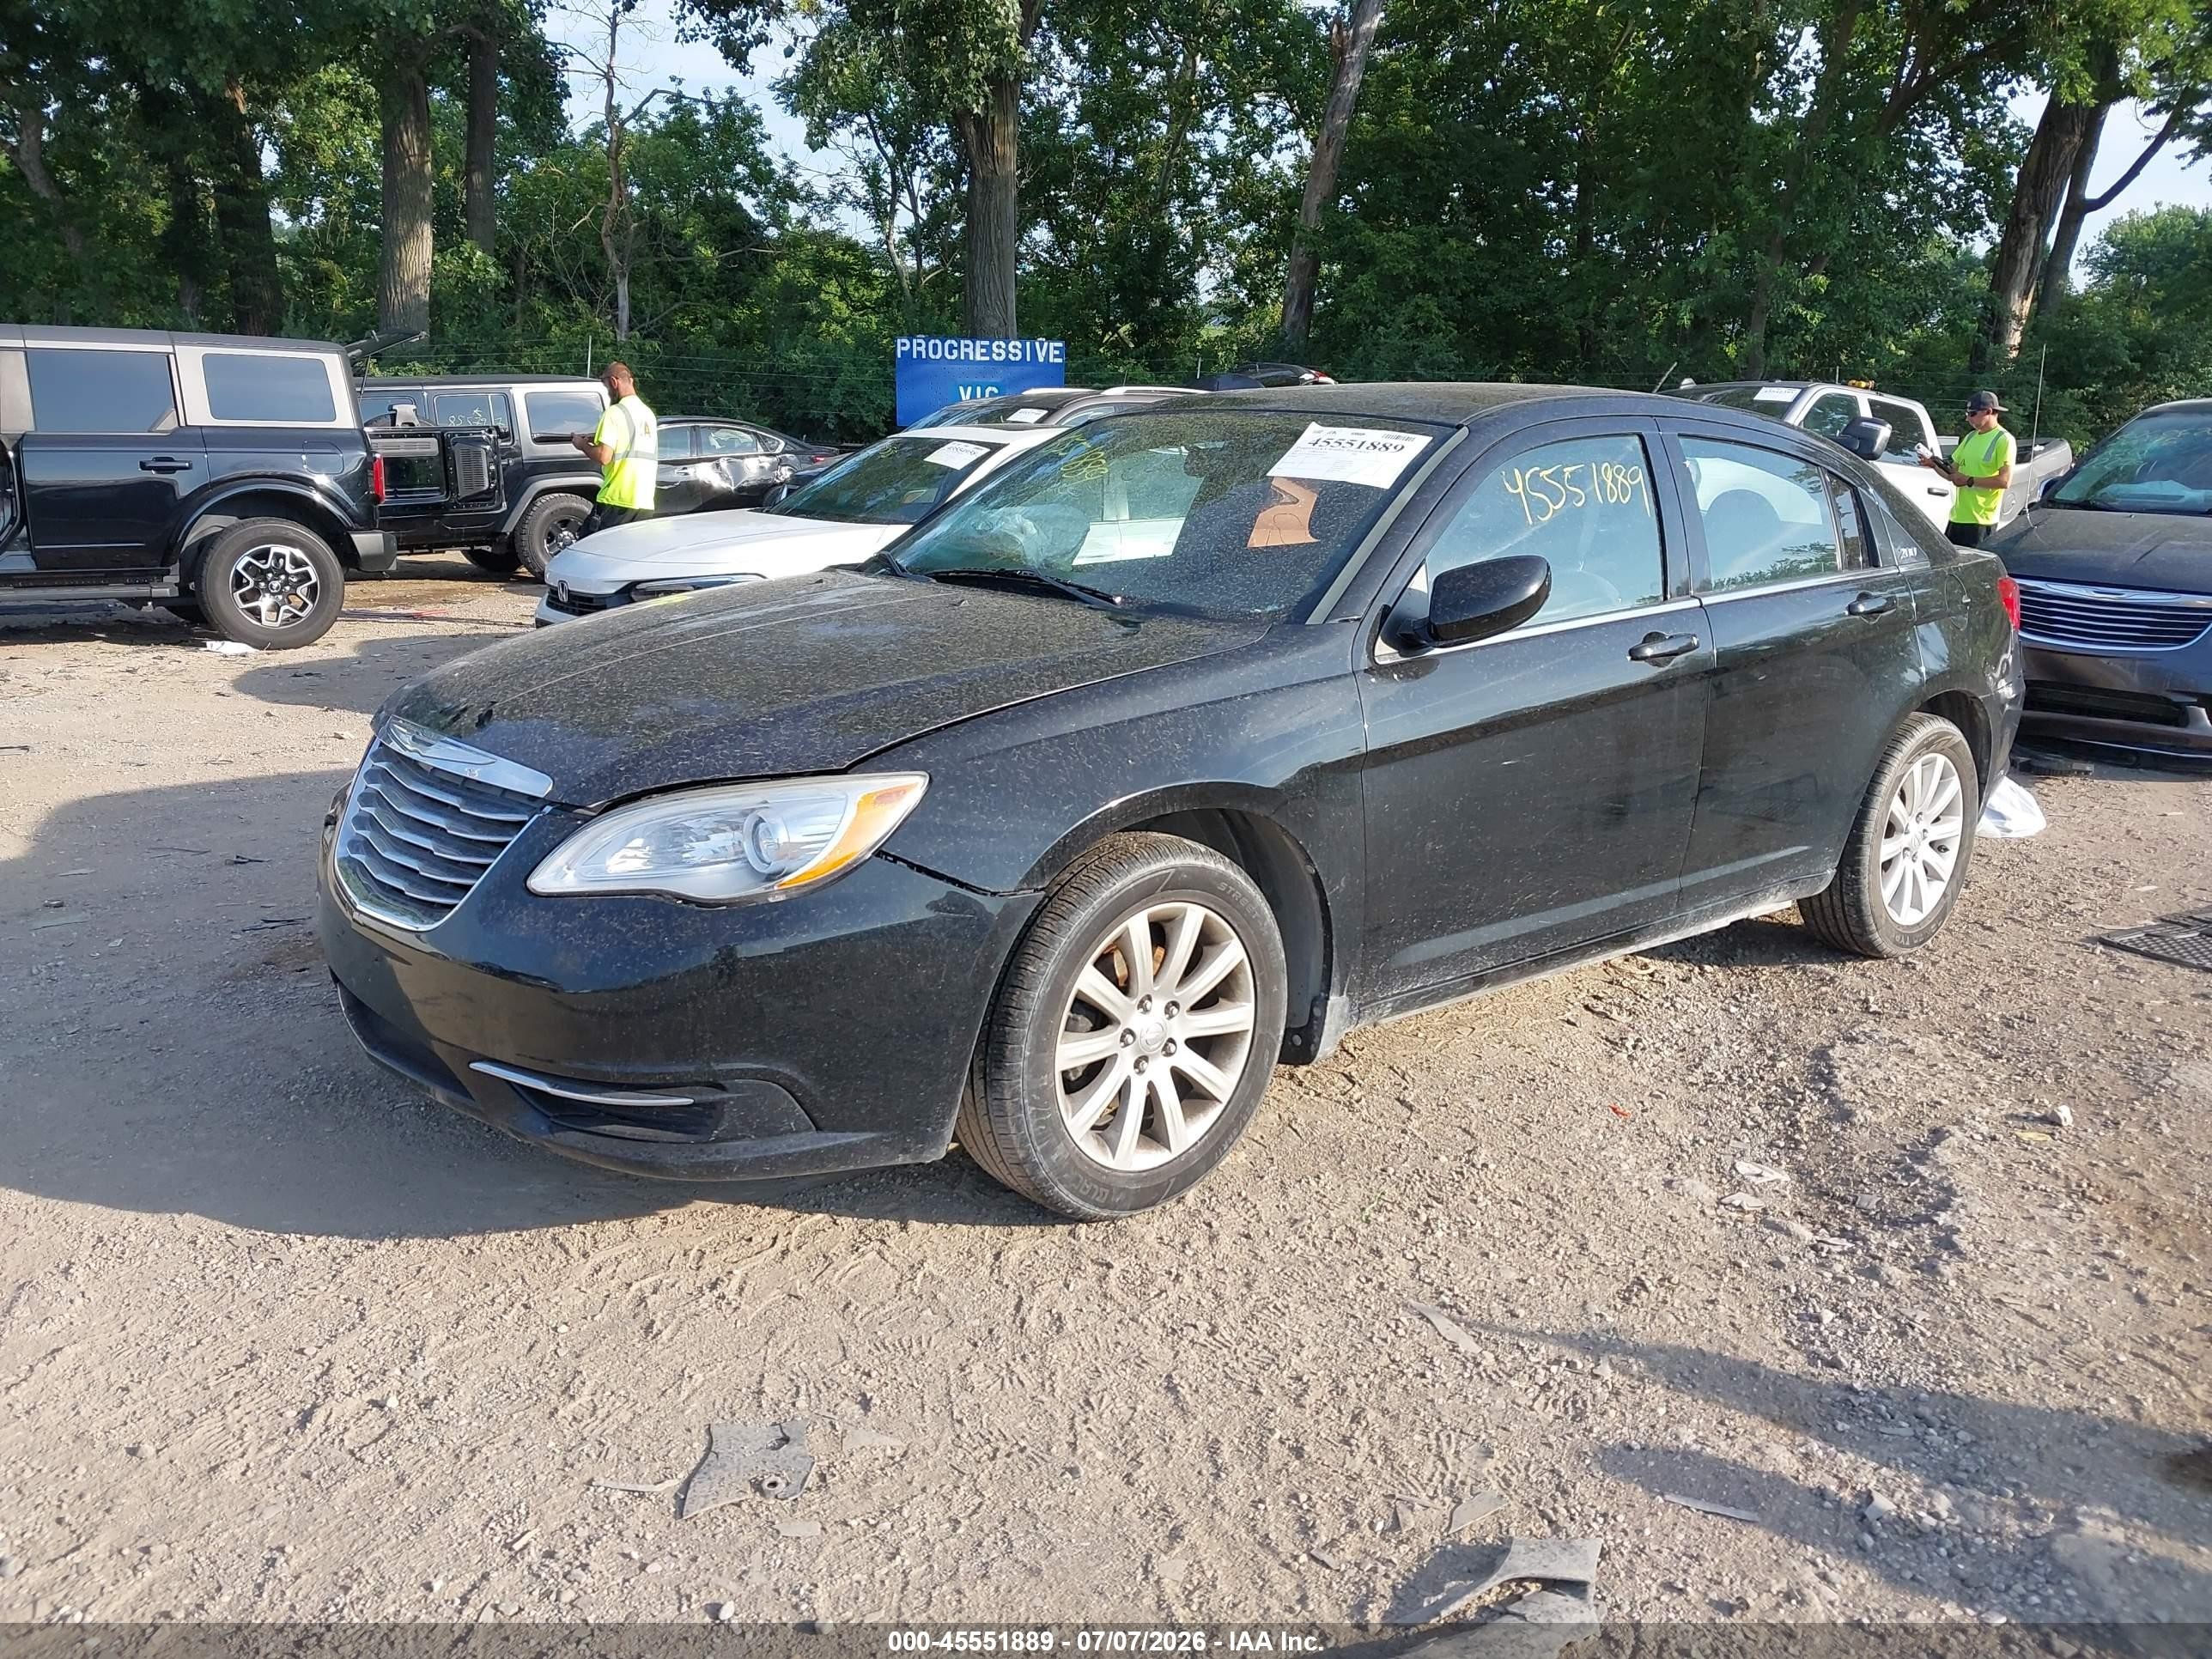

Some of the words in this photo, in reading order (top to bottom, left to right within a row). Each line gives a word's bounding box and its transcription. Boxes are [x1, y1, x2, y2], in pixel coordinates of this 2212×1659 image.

[896, 338, 1065, 363] PROGRESSIVE
[1308, 437, 1406, 453] 45551889
[1501, 461, 1651, 526] 45551889
